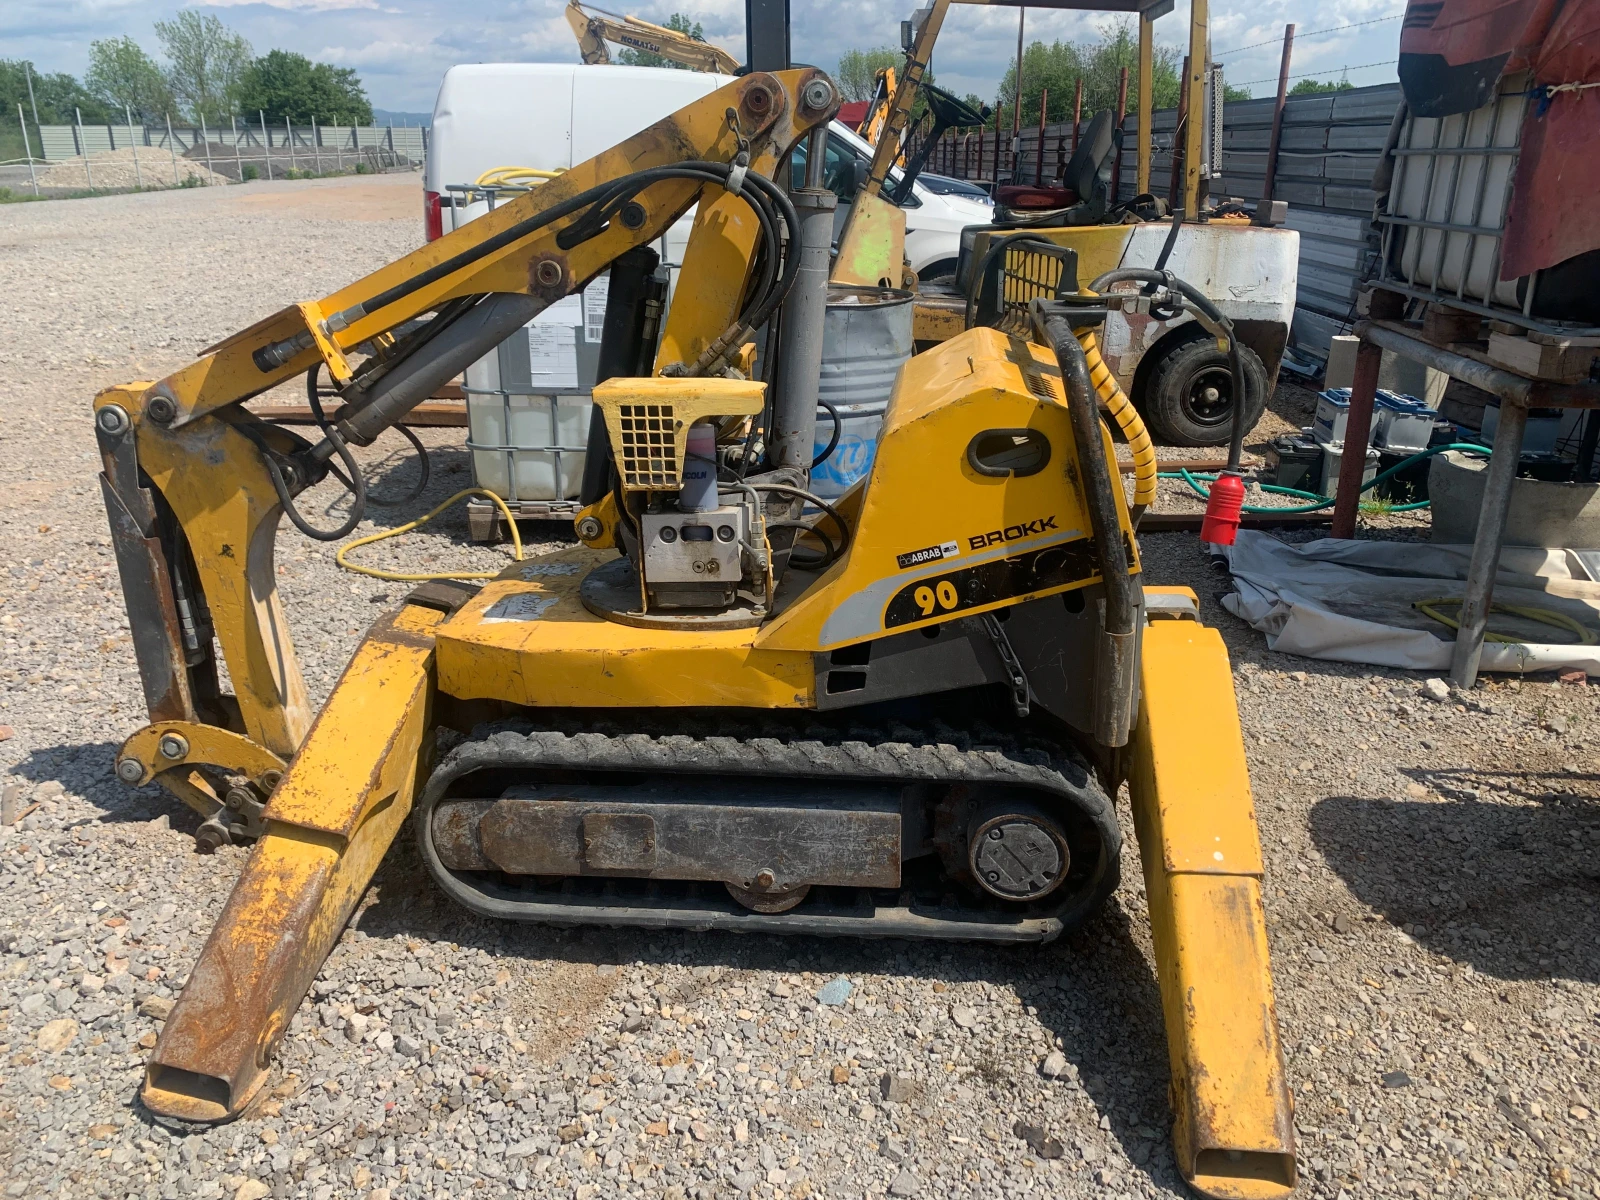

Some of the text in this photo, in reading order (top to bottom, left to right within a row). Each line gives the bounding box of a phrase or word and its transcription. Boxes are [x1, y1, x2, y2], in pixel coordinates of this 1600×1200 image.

[620, 35, 660, 52] KOMATSU
[967, 515, 1059, 551] BROKK
[911, 546, 942, 564] ABRAB
[914, 580, 959, 617] 90
